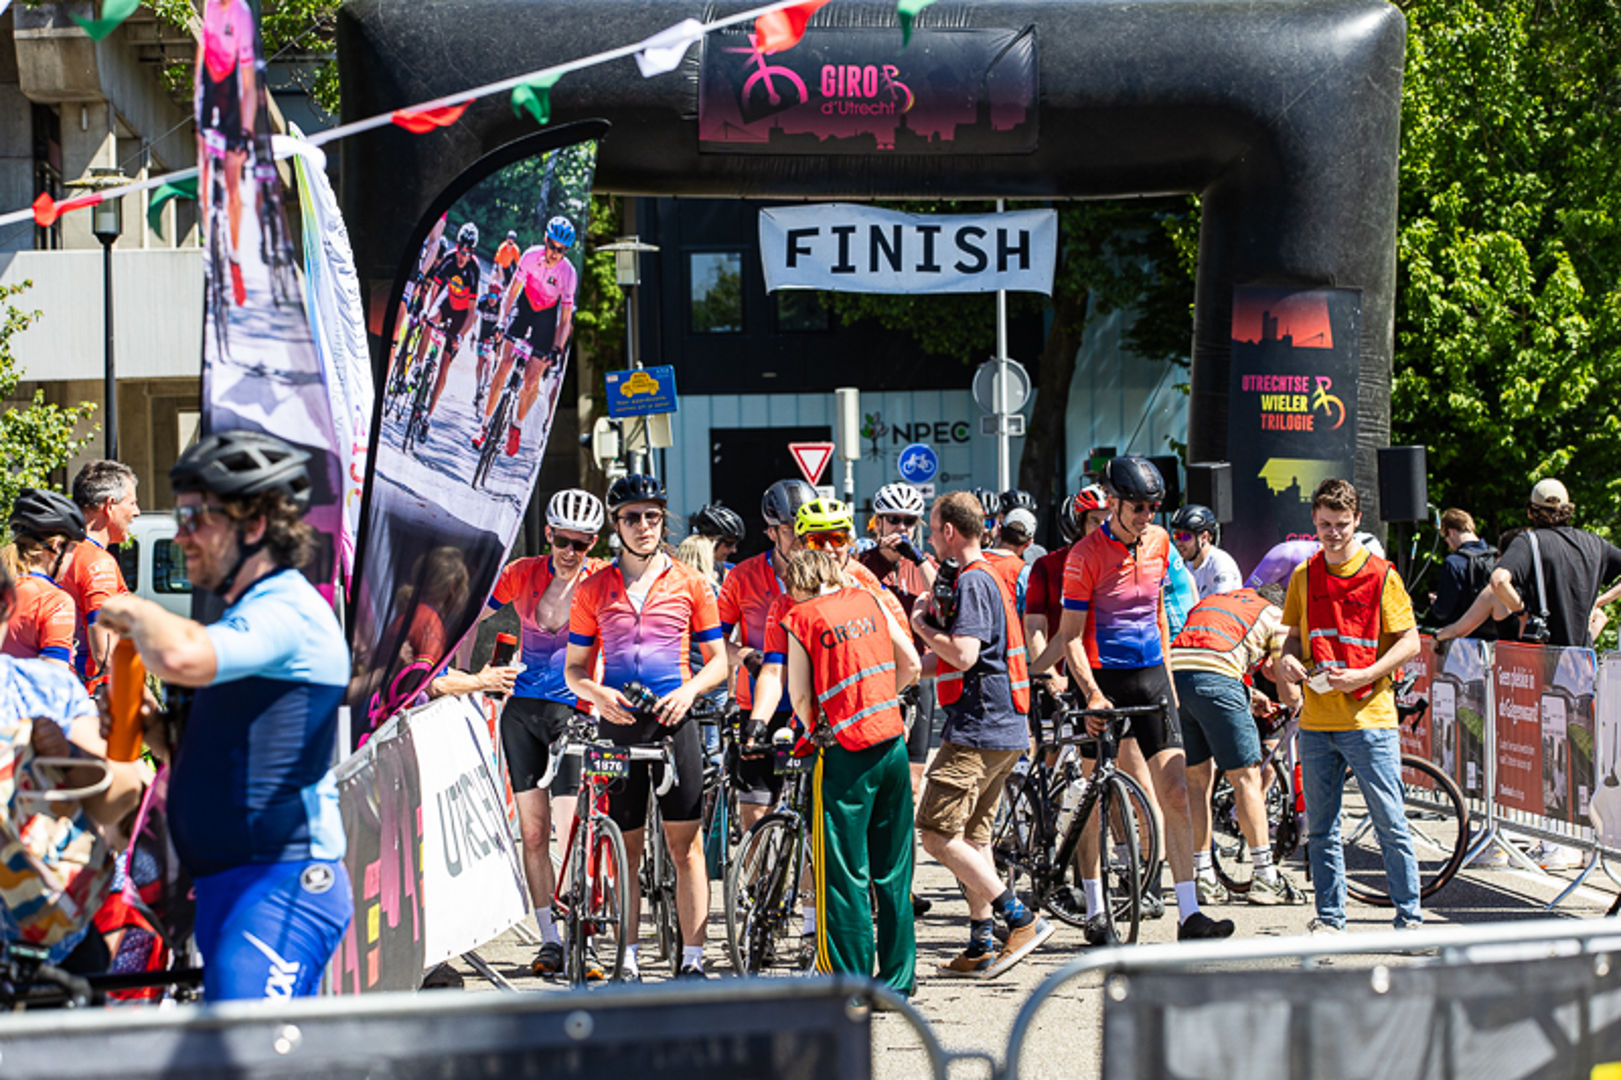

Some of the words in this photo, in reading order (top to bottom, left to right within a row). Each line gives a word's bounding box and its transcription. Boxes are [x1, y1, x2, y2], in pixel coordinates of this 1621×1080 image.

[821, 64, 878, 98] GIRO
[821, 101, 896, 115] d'Utrecht
[786, 225, 1030, 274] FINISH
[1241, 375, 1310, 392] UTRECHTSE
[1261, 394, 1309, 412] WIELER
[892, 421, 971, 444] NPEC
[1261, 413, 1315, 432] TRILOGIE
[820, 615, 876, 649] CREW
